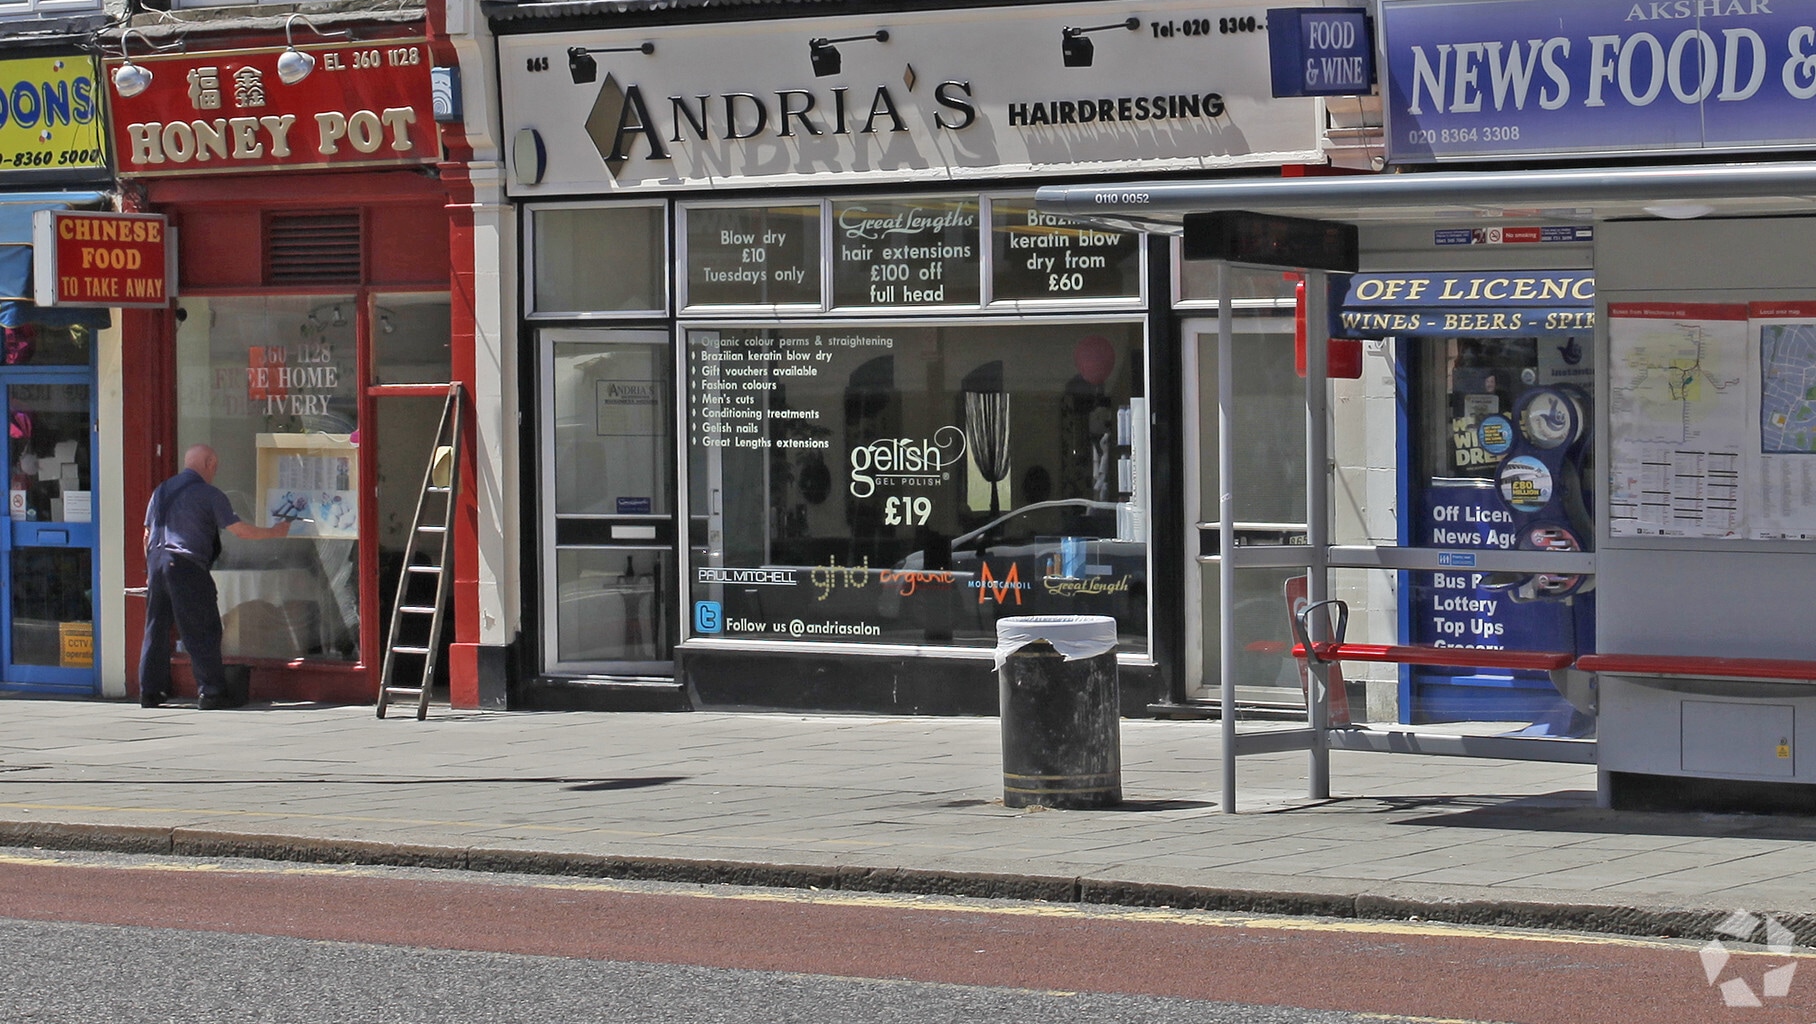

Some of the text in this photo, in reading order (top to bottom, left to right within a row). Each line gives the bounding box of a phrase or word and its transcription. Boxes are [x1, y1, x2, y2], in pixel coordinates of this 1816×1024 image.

[1151, 16, 1270, 38] Tel-020 8360-
[1309, 21, 1355, 50] FOOD
[321, 47, 420, 71] EL 360 1128
[527, 57, 549, 72] 865
[1306, 57, 1364, 86] & WINE
[1408, 25, 1816, 116] NEWS FOOD &
[0, 76, 95, 130] ONS
[603, 63, 976, 160] ANDRIA'S
[1008, 92, 1226, 127] HAIRDRESSING
[128, 106, 416, 164] HONEY POT
[1409, 126, 1520, 145] 020 8364 3308
[0, 150, 53, 168] -8360
[1095, 193, 1149, 204] 0110 0052
[839, 201, 974, 239] Great Lengths
[60, 219, 160, 243] CHINESE
[721, 229, 786, 247] Blow dry
[1010, 229, 1121, 249] keratin blow
[82, 248, 141, 269] FOOD
[742, 248, 766, 263] £10
[842, 242, 971, 261] hair extensions
[1027, 250, 1105, 273] dry from
[703, 266, 805, 284] Tuesdays only
[870, 262, 942, 281] £100 off
[62, 277, 162, 298] TO TAKE AWAY
[1049, 273, 1084, 291] £60
[1356, 279, 1430, 301] OFF
[870, 284, 944, 303] full head
[1341, 313, 1421, 330] WINES
[1443, 313, 1522, 330] BEERS
[702, 336, 894, 349] Organic colour perms & straightening
[702, 351, 833, 363] Brazilian keratin blow dry
[279, 366, 338, 388] HOME
[702, 365, 818, 376] Gift vouchers available
[702, 379, 777, 390] Fashion colours
[226, 394, 332, 416] DIVERY
[702, 394, 755, 404] Men's cuts
[702, 408, 820, 421] Conditioning treatments
[702, 422, 759, 433] Gelish nails
[702, 436, 830, 449] Great Lengths extensions
[850, 438, 942, 498] gelish
[875, 478, 941, 486] GEL POLISH
[1512, 481, 1533, 490] £80
[885, 496, 932, 526] £19
[1433, 506, 1459, 522] Off
[1433, 528, 1481, 544] News
[699, 569, 796, 583] PAUL MITCHELL
[811, 554, 868, 601] ghd
[1043, 574, 1088, 597] Great
[1434, 573, 1466, 589] Bus
[1433, 595, 1497, 616] Lottery
[726, 617, 766, 632] Follow
[773, 622, 786, 633] us
[1433, 617, 1504, 638] Top Ups
[68, 639, 89, 647] CCTV
